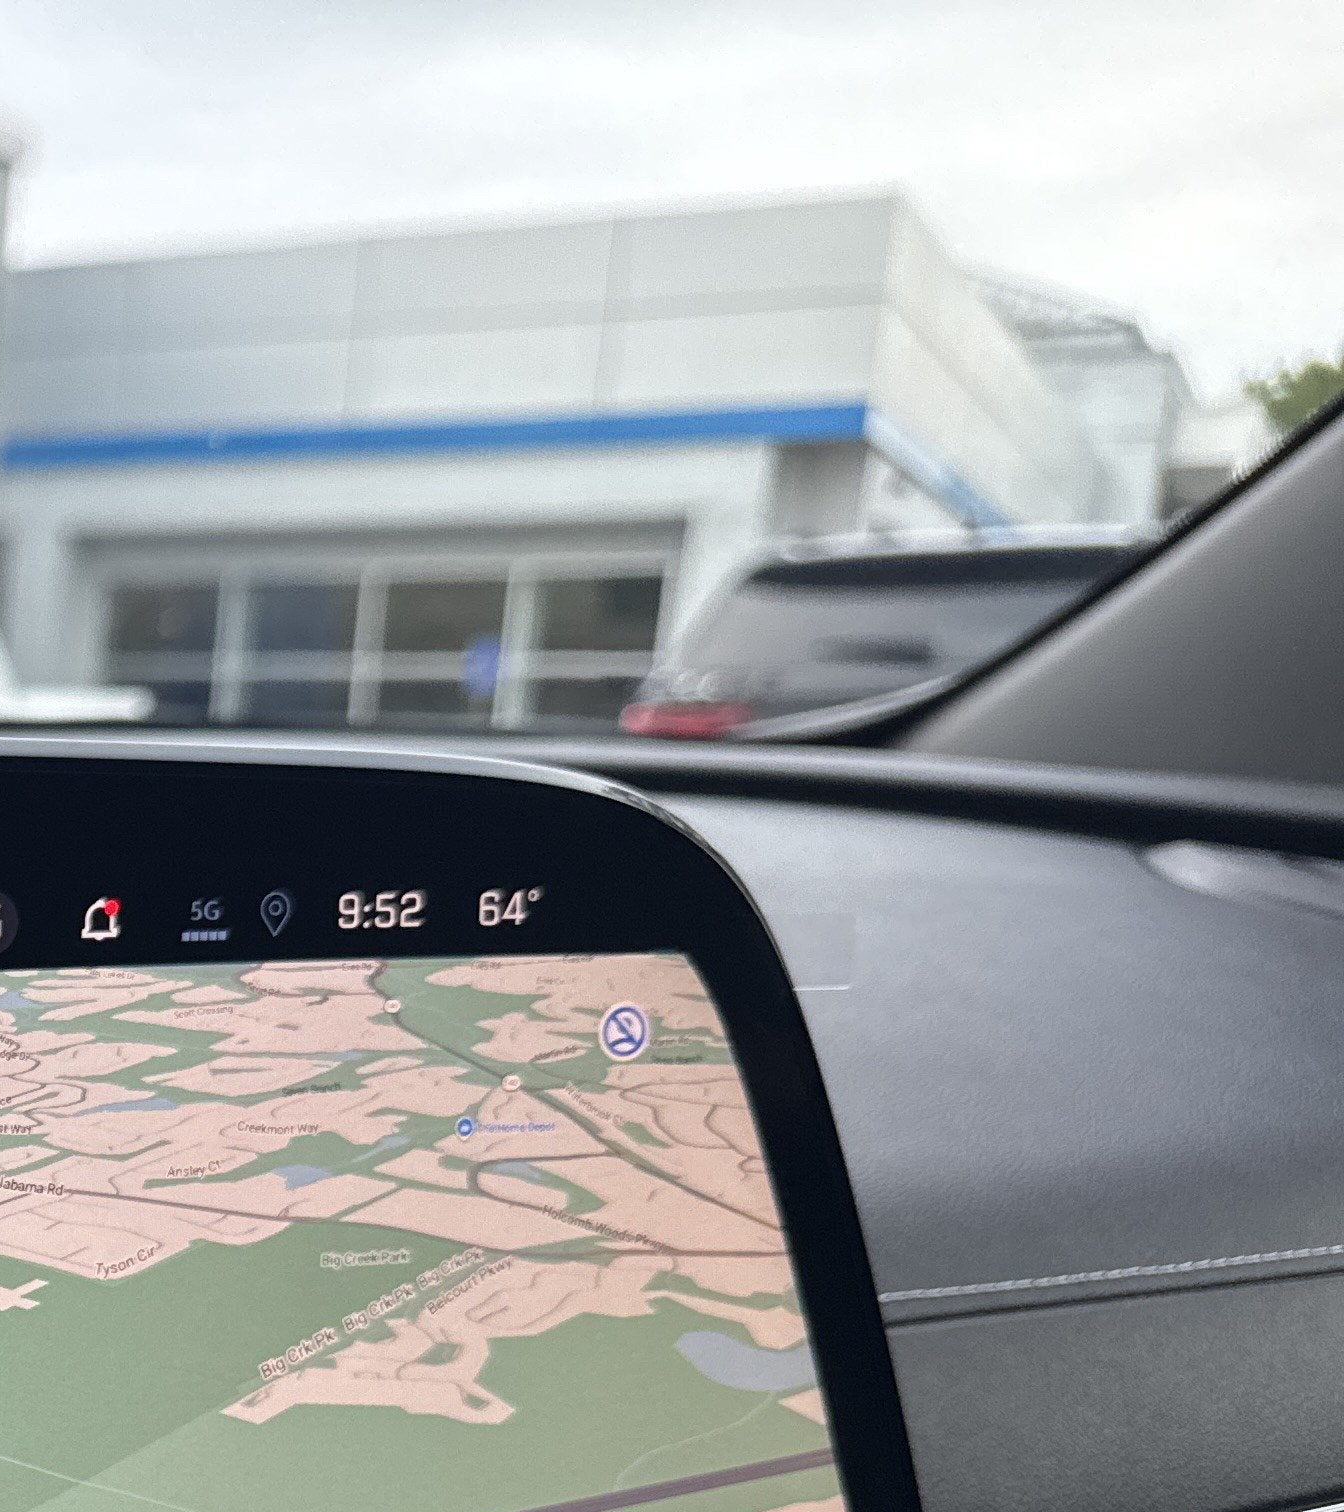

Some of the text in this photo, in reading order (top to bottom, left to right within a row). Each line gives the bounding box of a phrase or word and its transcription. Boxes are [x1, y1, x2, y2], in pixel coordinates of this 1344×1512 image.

[191, 901, 221, 921] 5G
[338, 892, 424, 928] 9:52
[479, 887, 543, 926] 64°
[47, 1182, 64, 1196] Rd
[95, 1246, 157, 1279] Tyson Cir
[381, 1250, 409, 1262] Park
[343, 1313, 367, 1331] Big
[261, 1329, 337, 1380] Big Crk Pk
